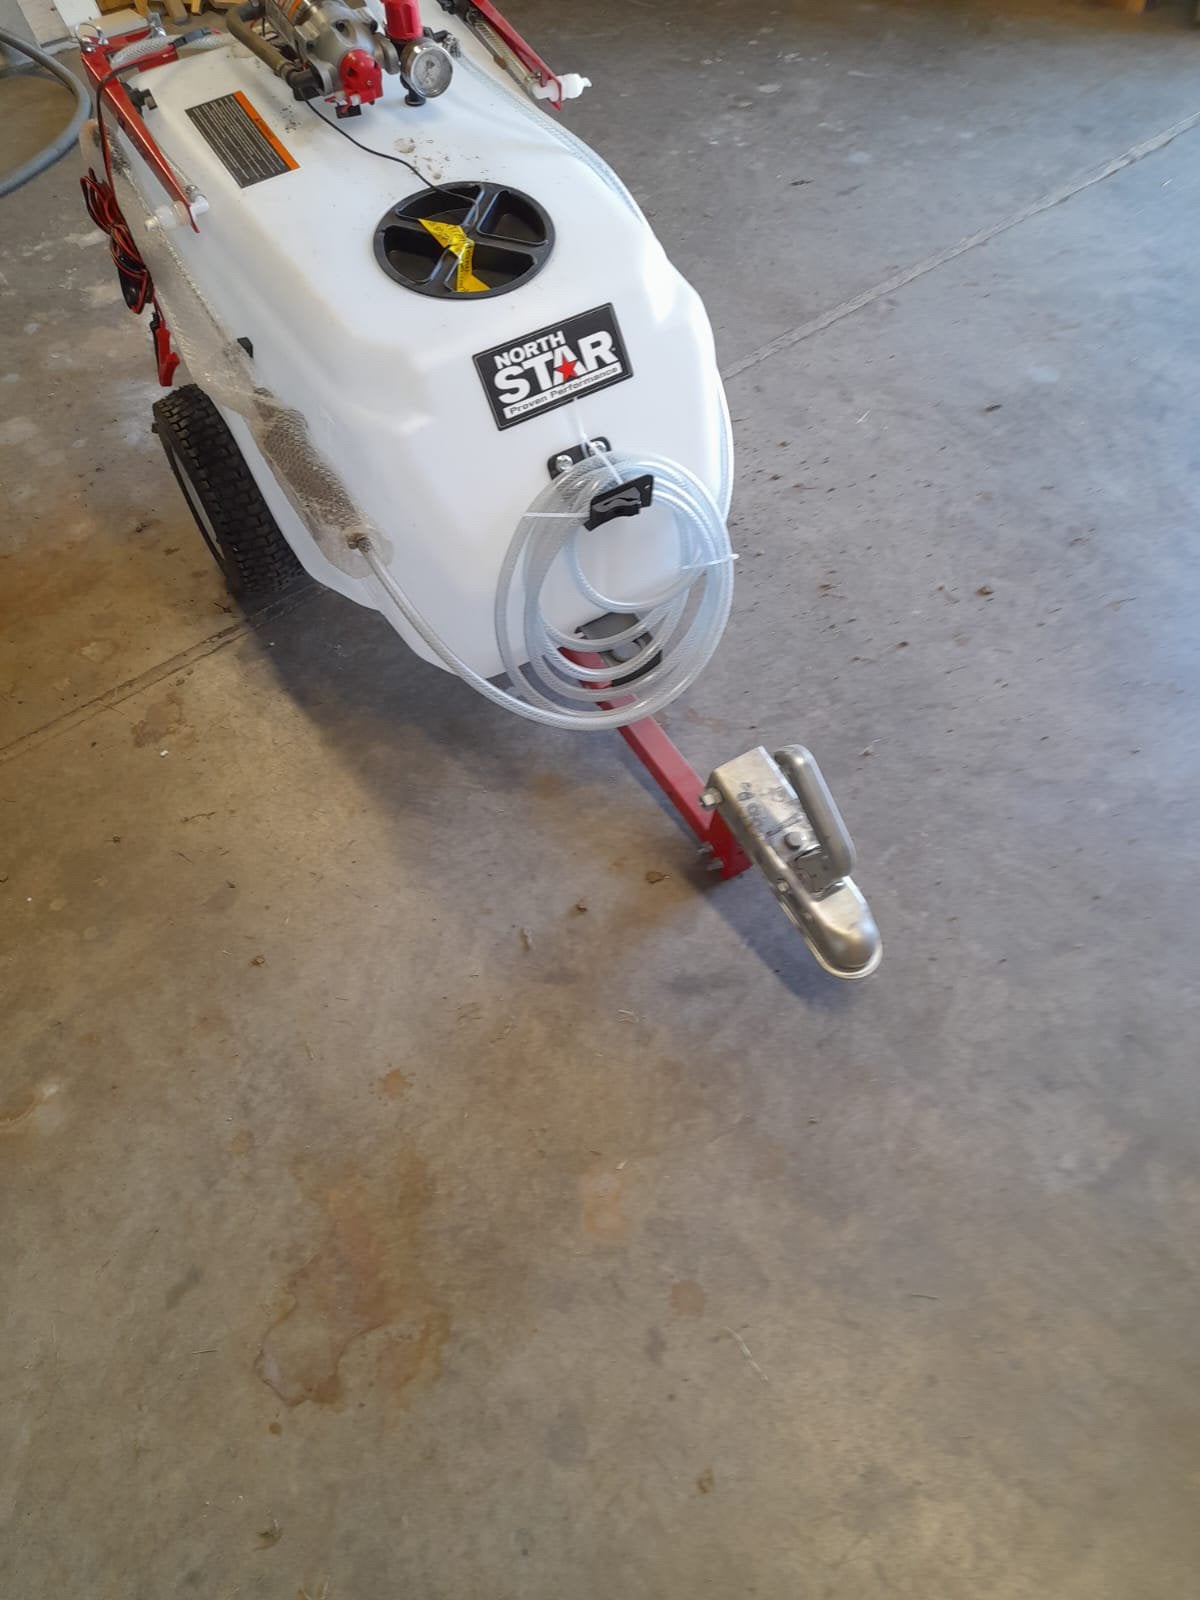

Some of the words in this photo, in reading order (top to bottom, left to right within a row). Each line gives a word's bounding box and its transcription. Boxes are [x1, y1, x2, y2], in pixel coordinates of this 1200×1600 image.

[494, 330, 567, 369] NORTH
[494, 330, 619, 404] STAR
[509, 395, 549, 415] Proven
[550, 366, 619, 398] Performance
